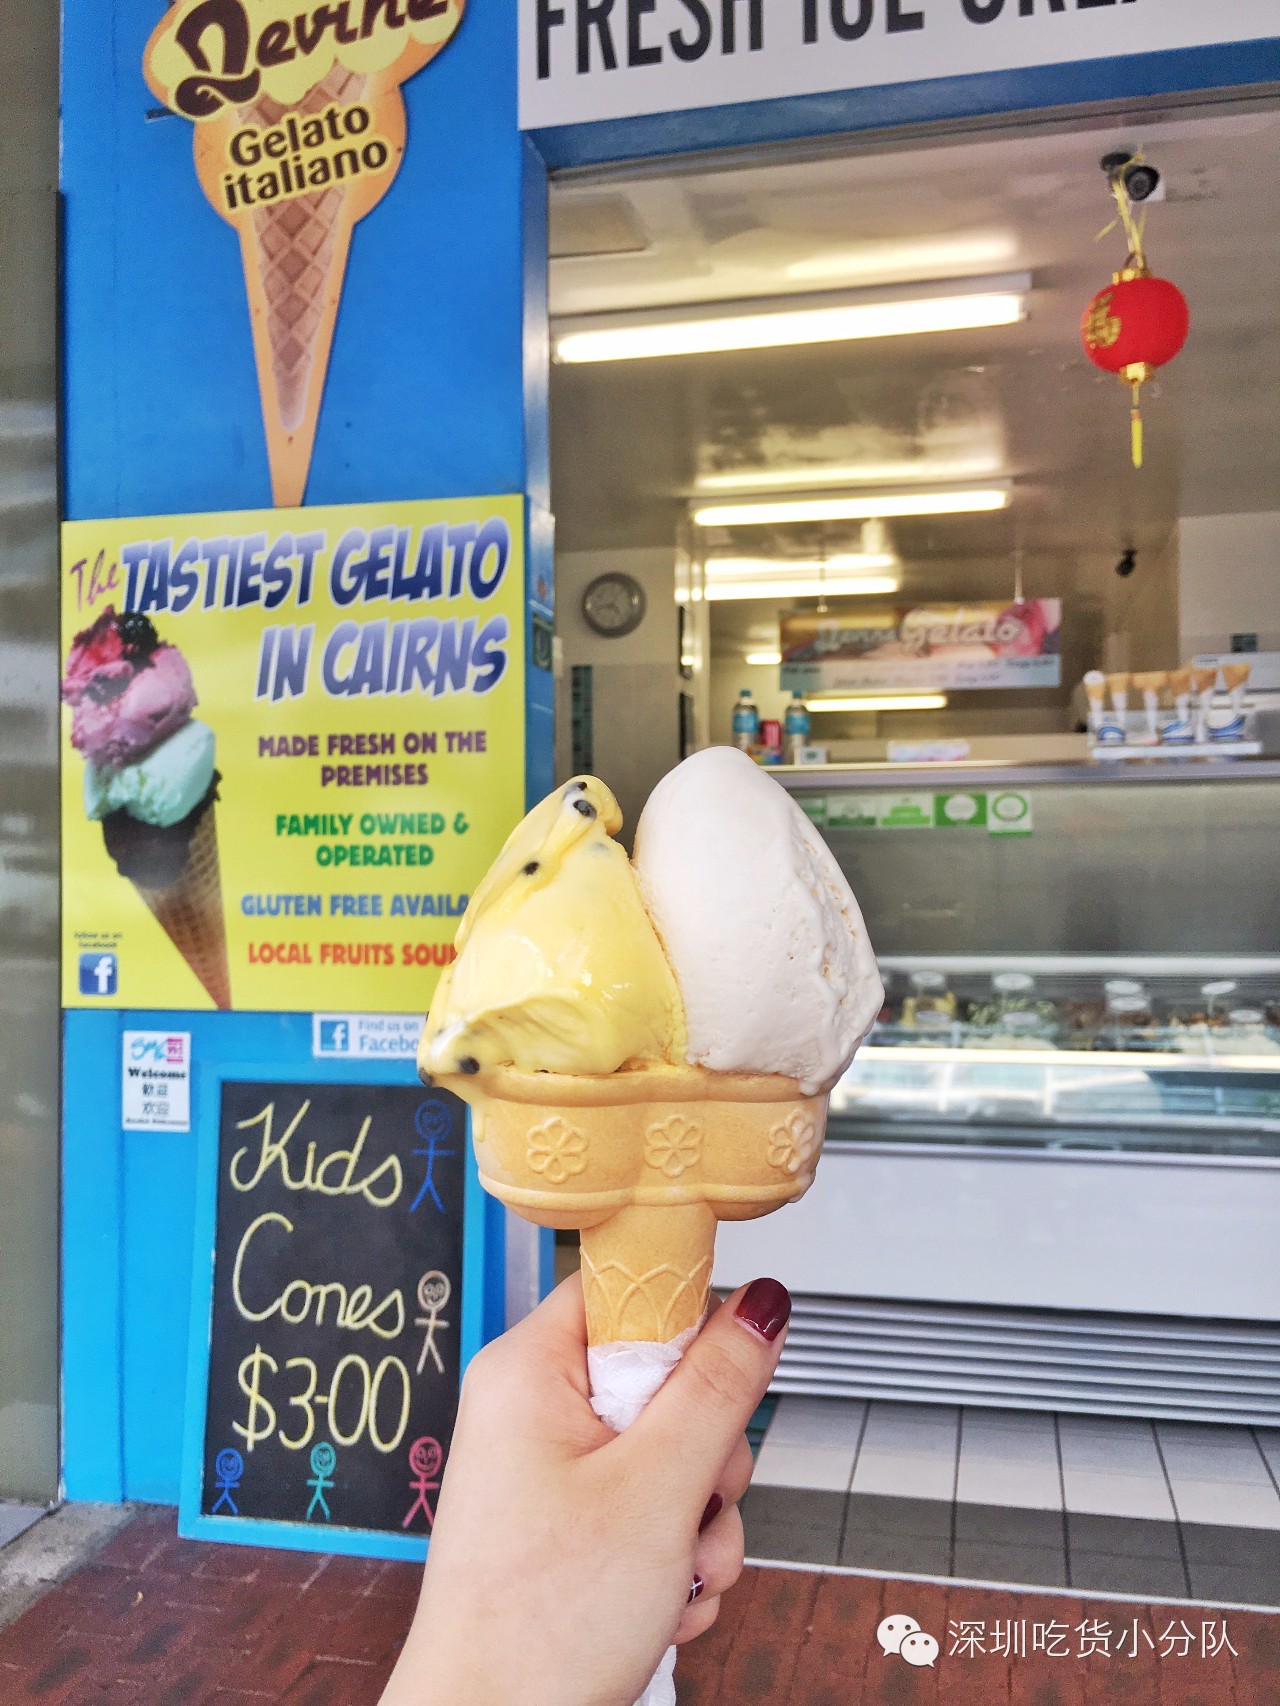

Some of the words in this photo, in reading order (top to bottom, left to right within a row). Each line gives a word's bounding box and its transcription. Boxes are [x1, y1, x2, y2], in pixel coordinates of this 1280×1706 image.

[229, 105, 370, 167] Gelato
[223, 139, 389, 210] italiano
[70, 548, 120, 611] The
[119, 531, 326, 615] TASTIEST
[328, 516, 510, 607] GELATO
[256, 621, 317, 705] IN
[320, 615, 510, 699] CAIRNS
[258, 735, 320, 757] MADE
[327, 733, 396, 756] FRESH
[403, 733, 439, 754] ON
[446, 731, 487, 753] THE
[320, 763, 429, 787] PREMISES
[276, 814, 351, 837] FAMILY
[360, 813, 446, 835] OWNED
[454, 813, 469, 834] &
[316, 845, 434, 867] OPERATED
[241, 894, 322, 916] GLUTEN
[330, 894, 382, 916] FREE
[248, 943, 312, 964] LOCAL
[320, 943, 394, 965] FRUITS
[359, 1019, 385, 1031] Find
[128, 1066, 187, 1079] Welcome
[229, 1099, 404, 1207] Kids
[232, 1212, 405, 1339] Cones
